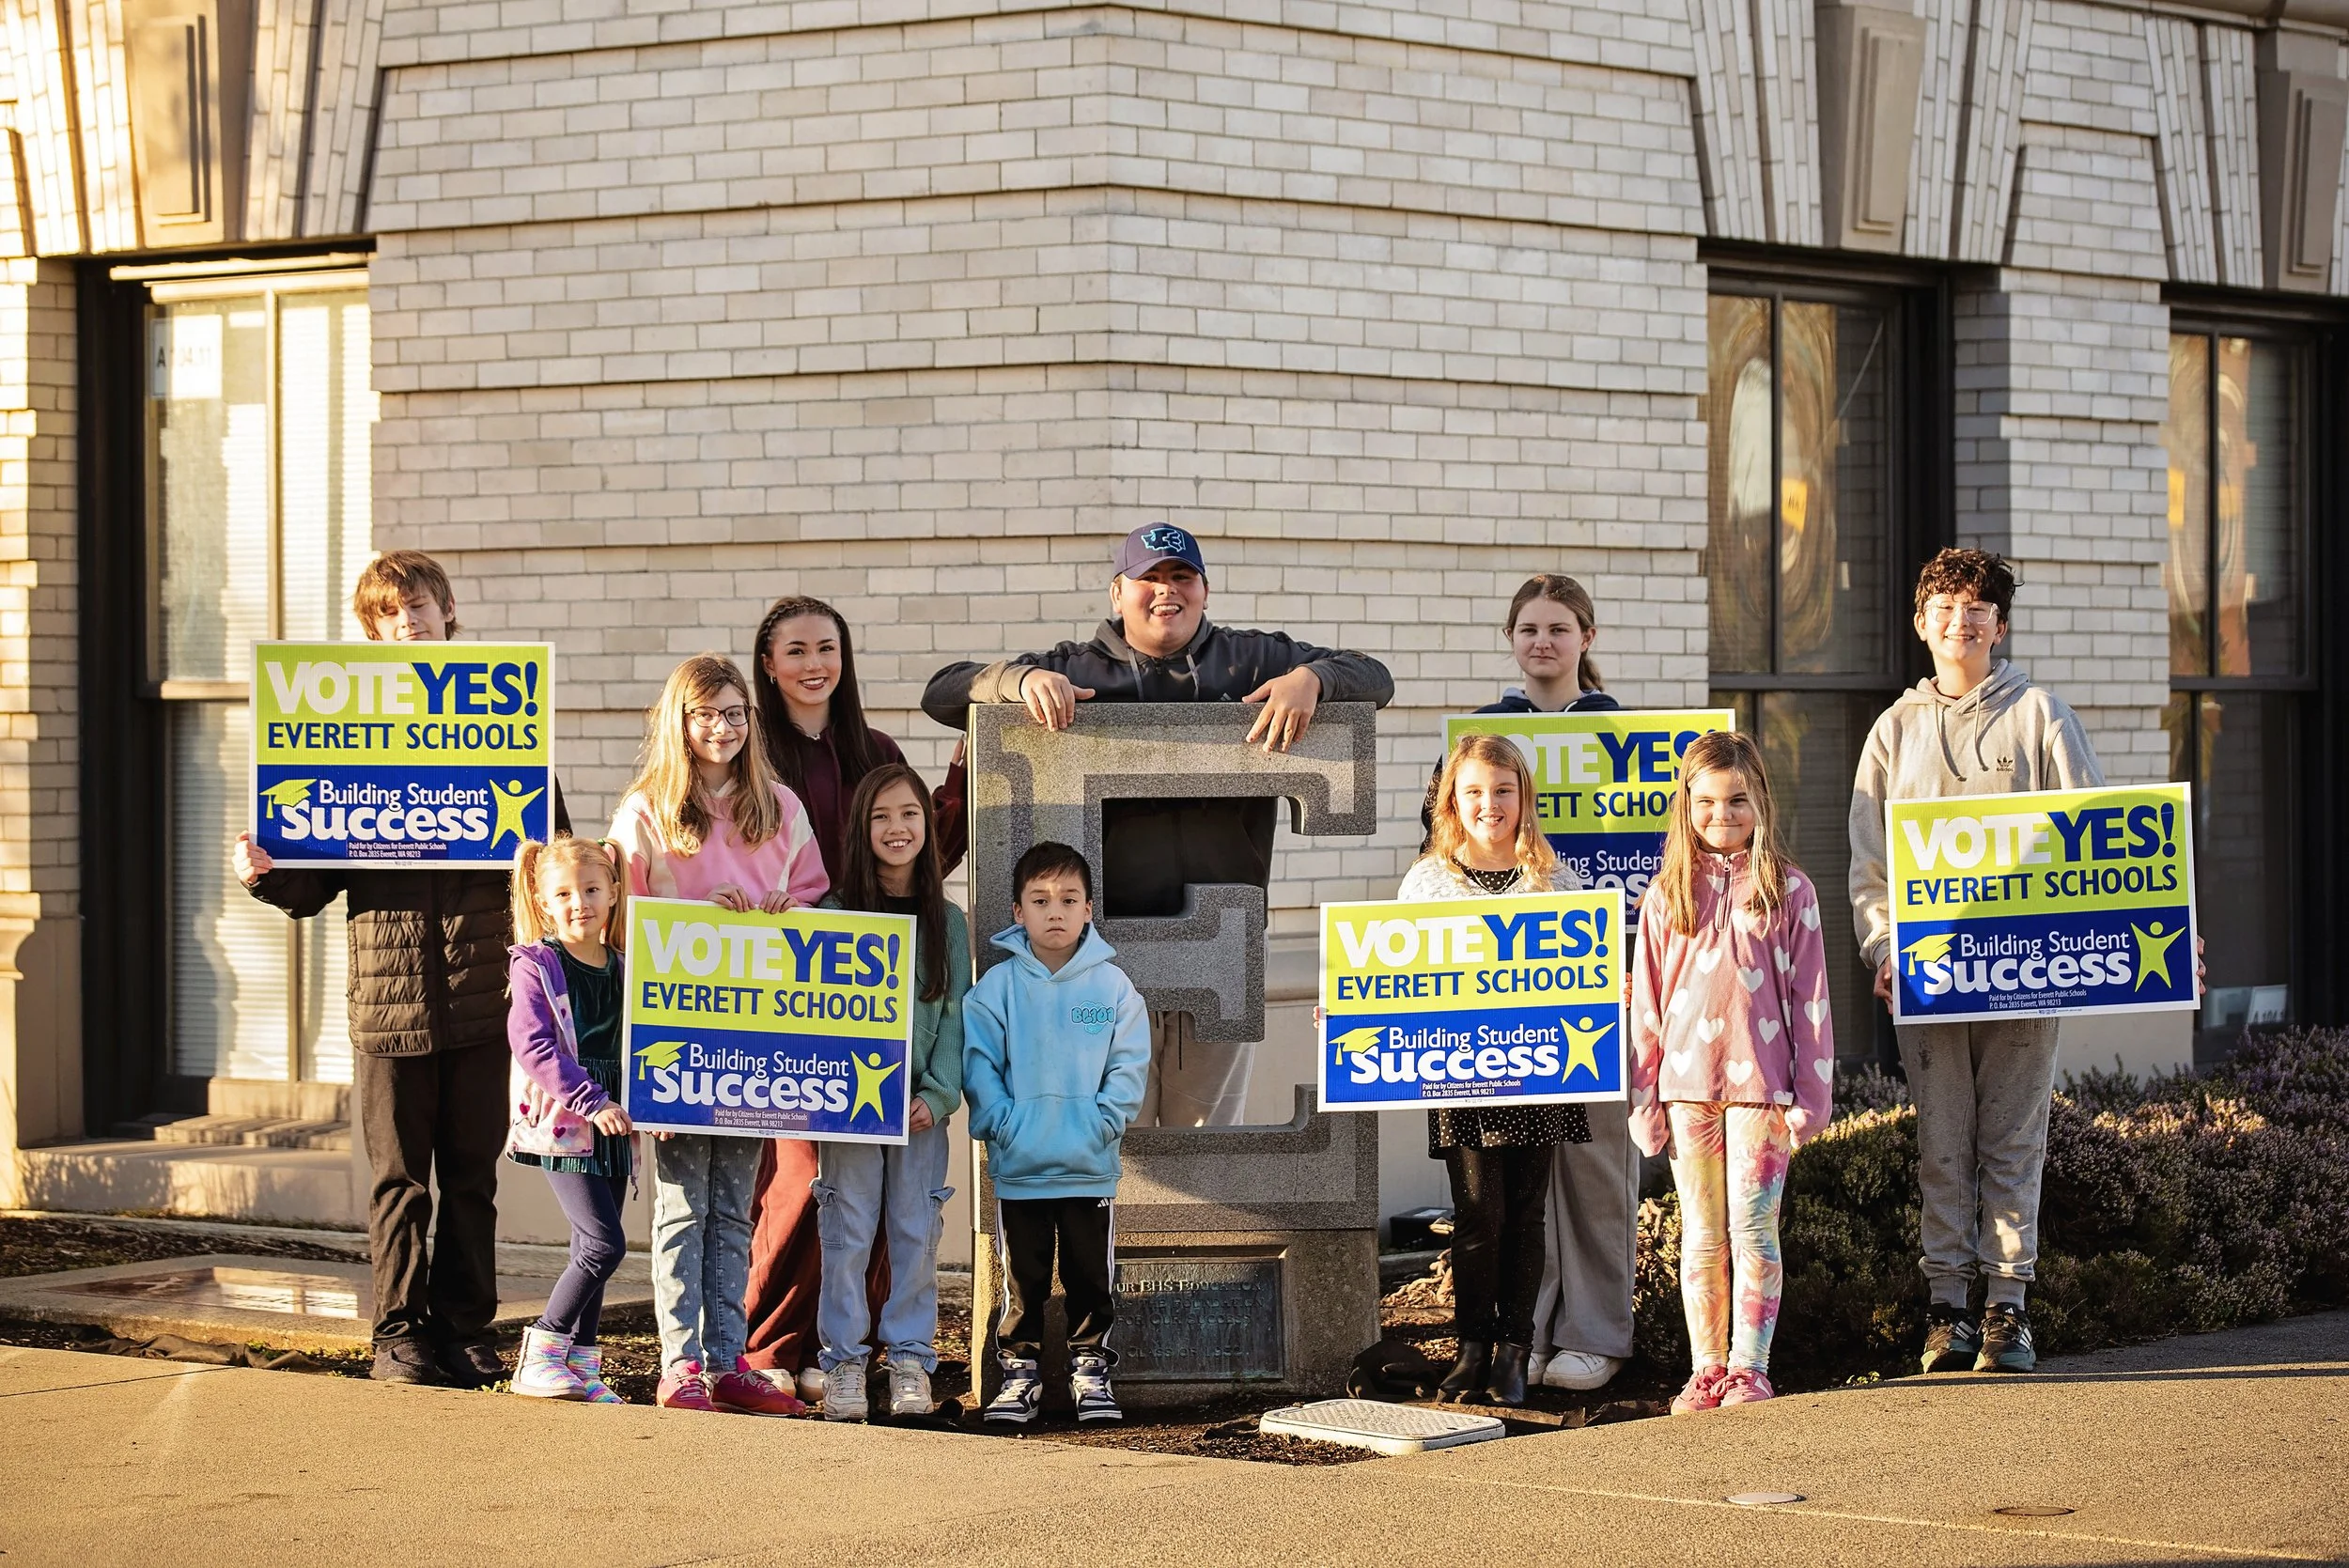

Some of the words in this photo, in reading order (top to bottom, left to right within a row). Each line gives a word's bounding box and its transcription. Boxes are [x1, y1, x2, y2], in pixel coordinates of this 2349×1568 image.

[265, 661, 414, 714] VOTE
[412, 661, 538, 717] YES!
[268, 722, 395, 749] EVERETT
[406, 722, 538, 750] SCHOOLS
[319, 779, 402, 812] Building
[408, 783, 489, 805] Student
[1595, 791, 1676, 817] SCHO
[281, 799, 490, 841] Success
[1900, 813, 2051, 871] VOTE
[2046, 802, 2176, 862] YES!
[1596, 850, 1662, 871] Studen
[1906, 873, 2032, 906] EVERETT
[2046, 864, 2178, 897] SCHOOLS
[642, 919, 784, 981] VOTE
[782, 927, 900, 990] YES!
[1335, 915, 1485, 968] VOTE
[1482, 907, 1609, 961] YES!
[1961, 933, 2043, 959] Building
[2048, 929, 2130, 954] Student
[1338, 971, 1465, 1000] EVERETT
[1476, 964, 1609, 995] SCHOOLS
[1924, 952, 2132, 995] Success
[643, 982, 763, 1015] EVERETT
[773, 989, 897, 1023] SCHOOLS
[1390, 1026, 1471, 1052] Building
[1478, 1023, 1559, 1045] Student
[690, 1044, 768, 1078] Building
[773, 1051, 848, 1077] Student
[1351, 1045, 1560, 1084] Success
[653, 1063, 848, 1112] Success
